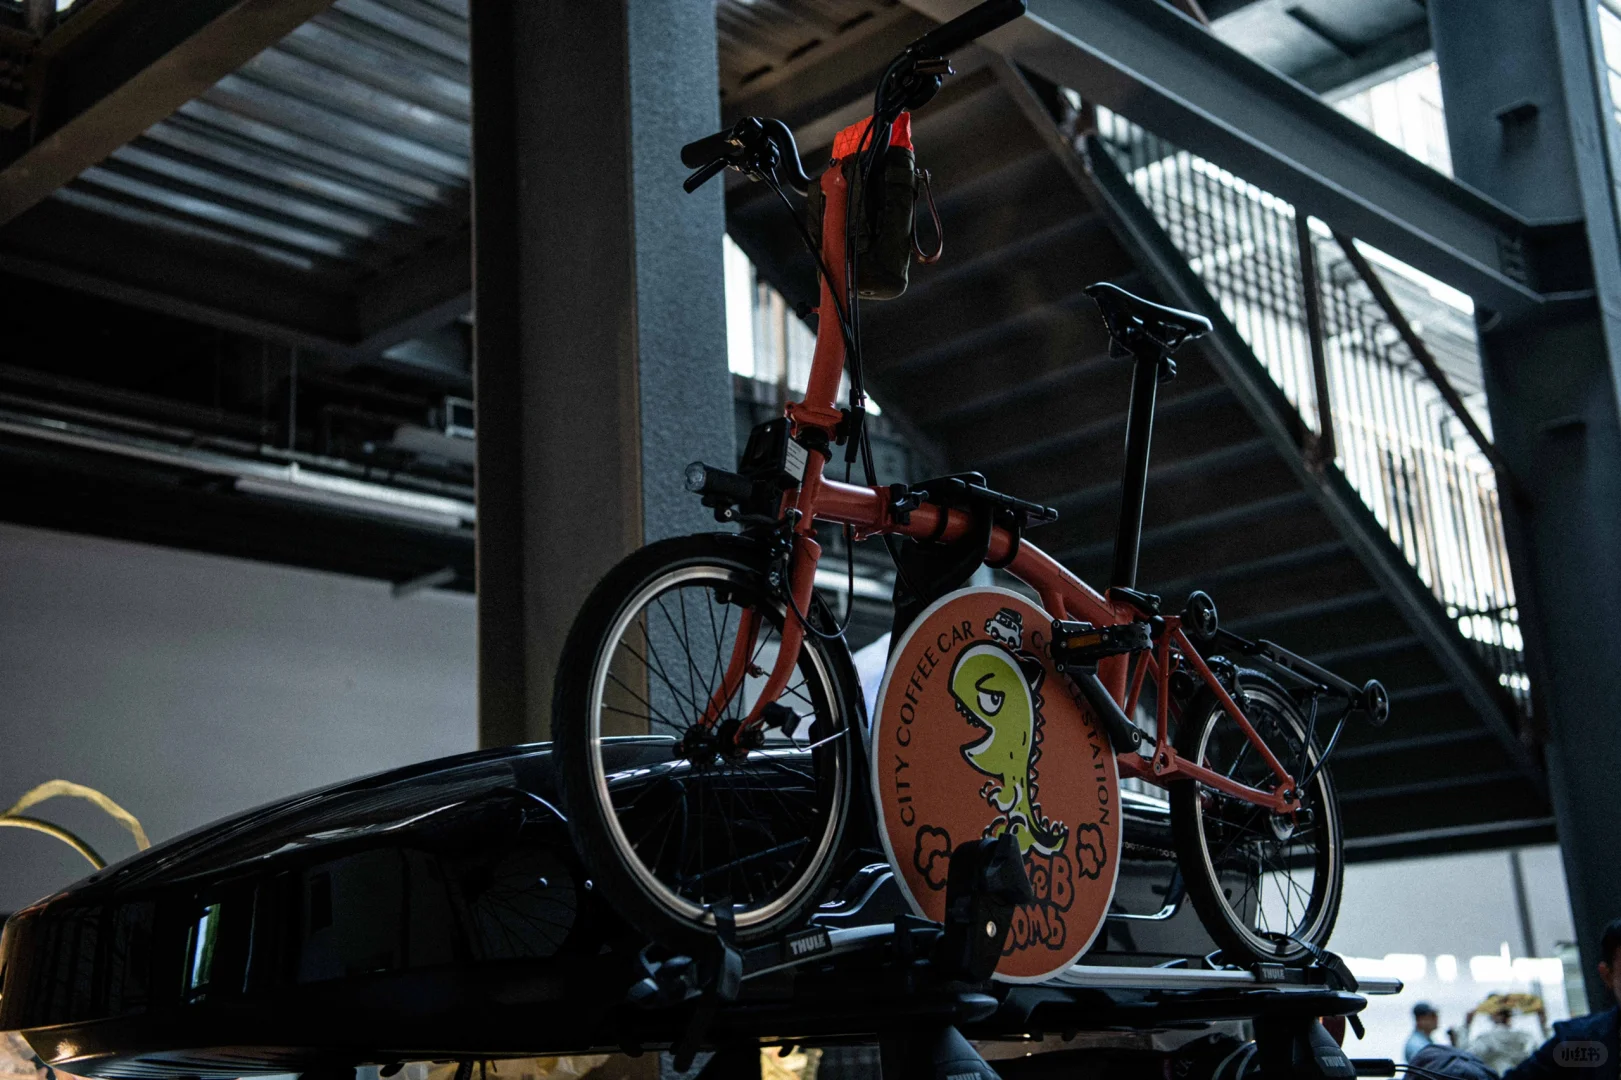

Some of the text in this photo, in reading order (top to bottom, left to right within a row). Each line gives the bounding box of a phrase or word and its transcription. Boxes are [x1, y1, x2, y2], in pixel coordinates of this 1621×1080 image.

[895, 620, 975, 827] CITY COFFEE CAR
[1082, 710, 1110, 825] STATION
[789, 933, 827, 956] THULE
[1000, 904, 1066, 956] omb
[1261, 967, 1286, 980] THULE
